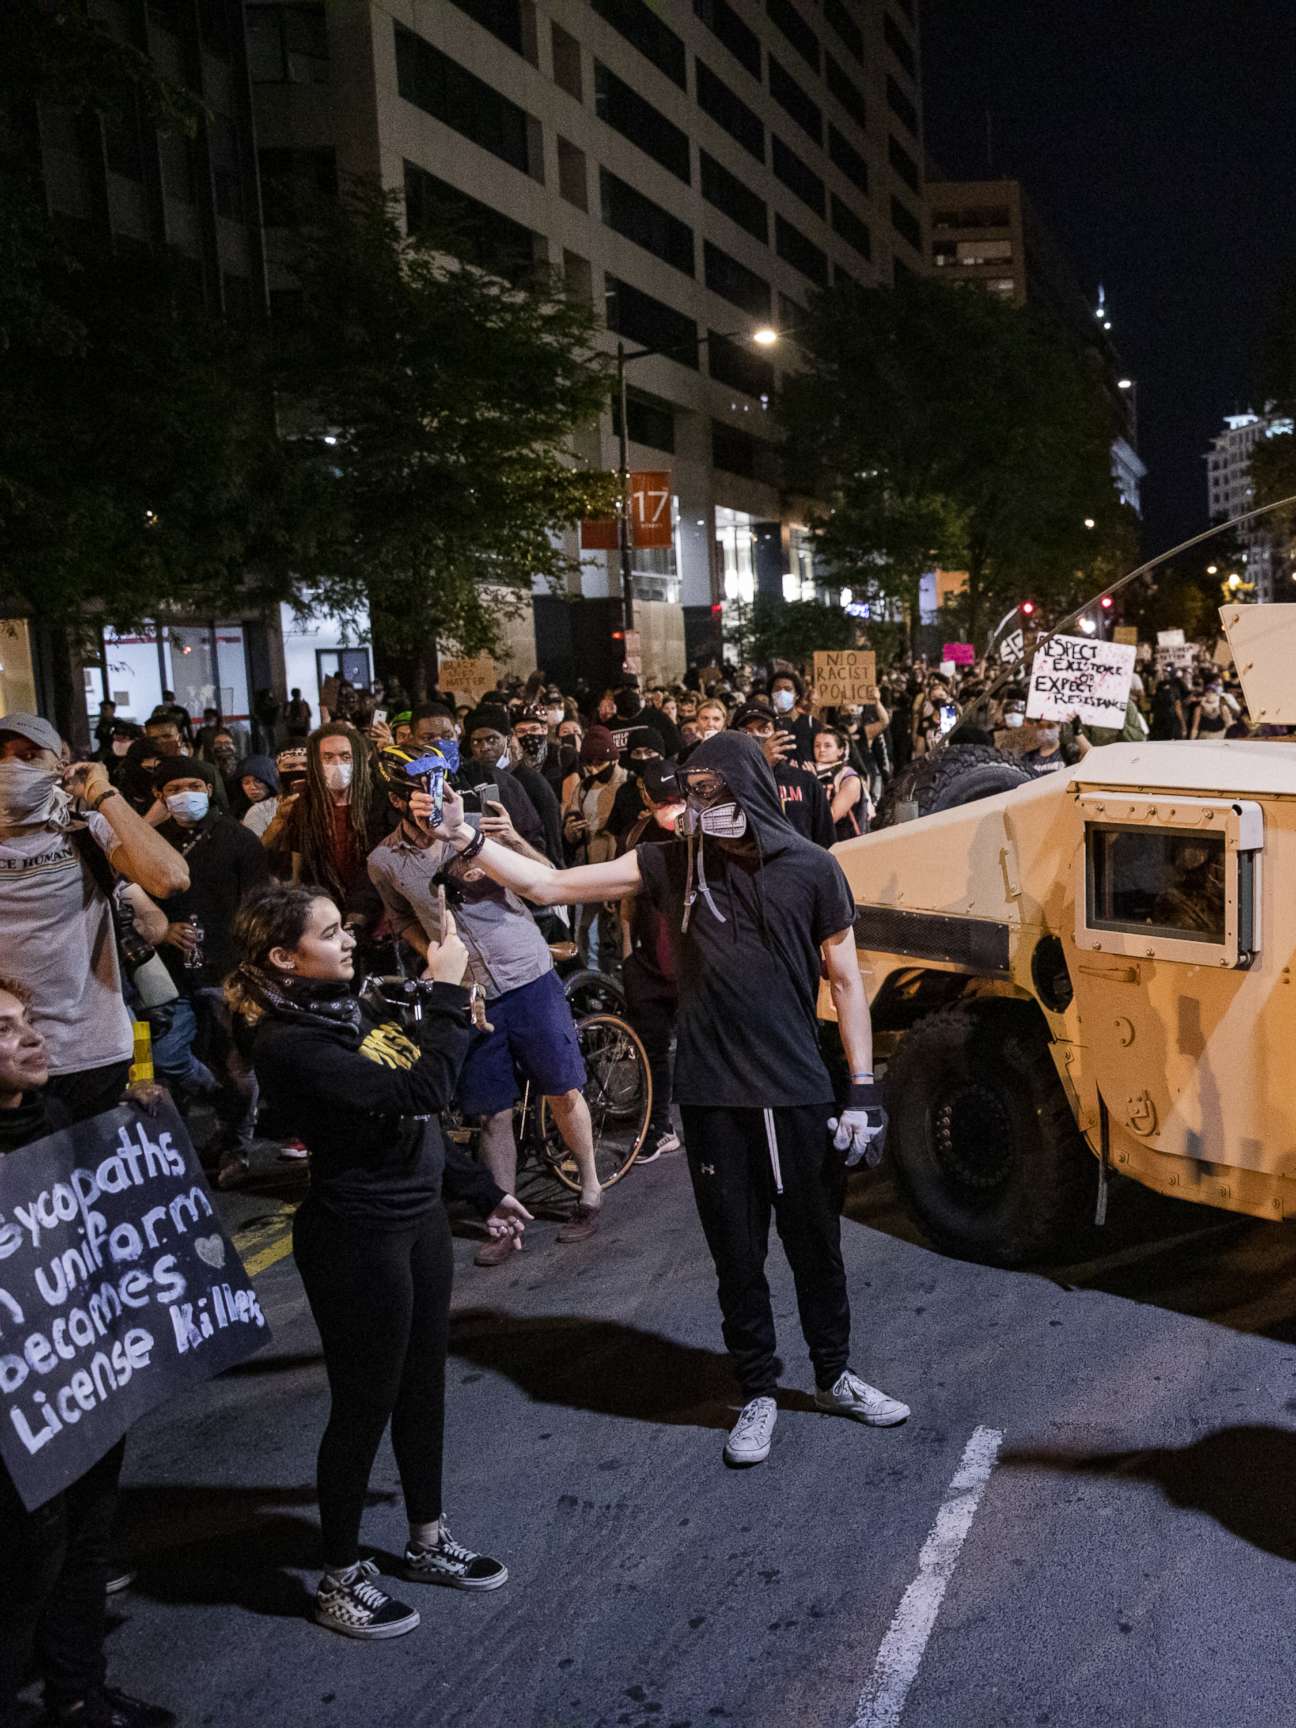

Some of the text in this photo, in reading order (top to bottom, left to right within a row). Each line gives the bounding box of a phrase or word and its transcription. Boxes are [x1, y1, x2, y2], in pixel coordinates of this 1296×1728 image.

[633, 490, 669, 522] 17
[816, 666, 868, 681] RACIST
[1035, 676, 1094, 694] EXPECT
[819, 683, 877, 701] POLICE
[34, 1186, 214, 1306] uniform
[10, 1327, 155, 1455] License
